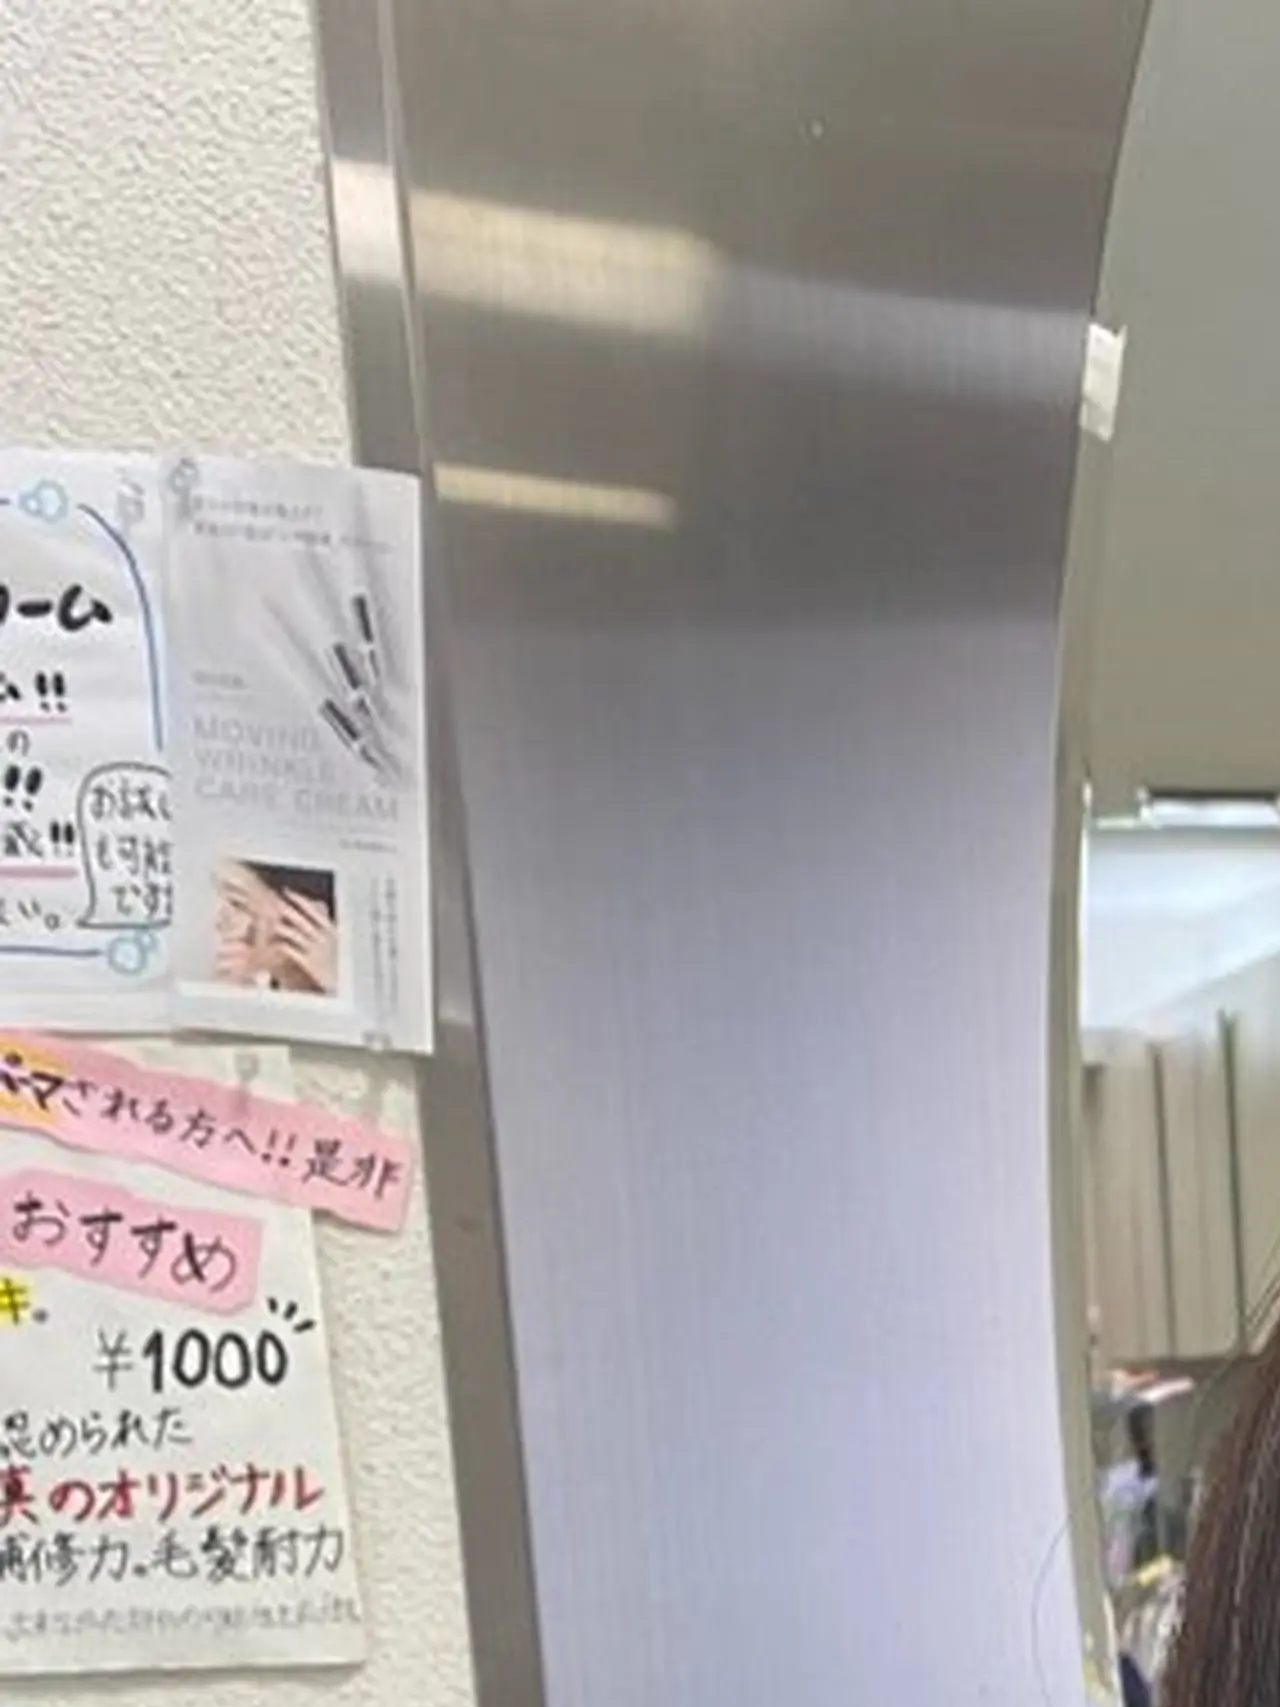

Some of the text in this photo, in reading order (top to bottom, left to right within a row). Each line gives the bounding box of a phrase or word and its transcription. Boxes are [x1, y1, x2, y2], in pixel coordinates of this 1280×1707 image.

[12, 1189, 238, 1293] おすすめ
[93, 1327, 290, 1393] ¥1000
